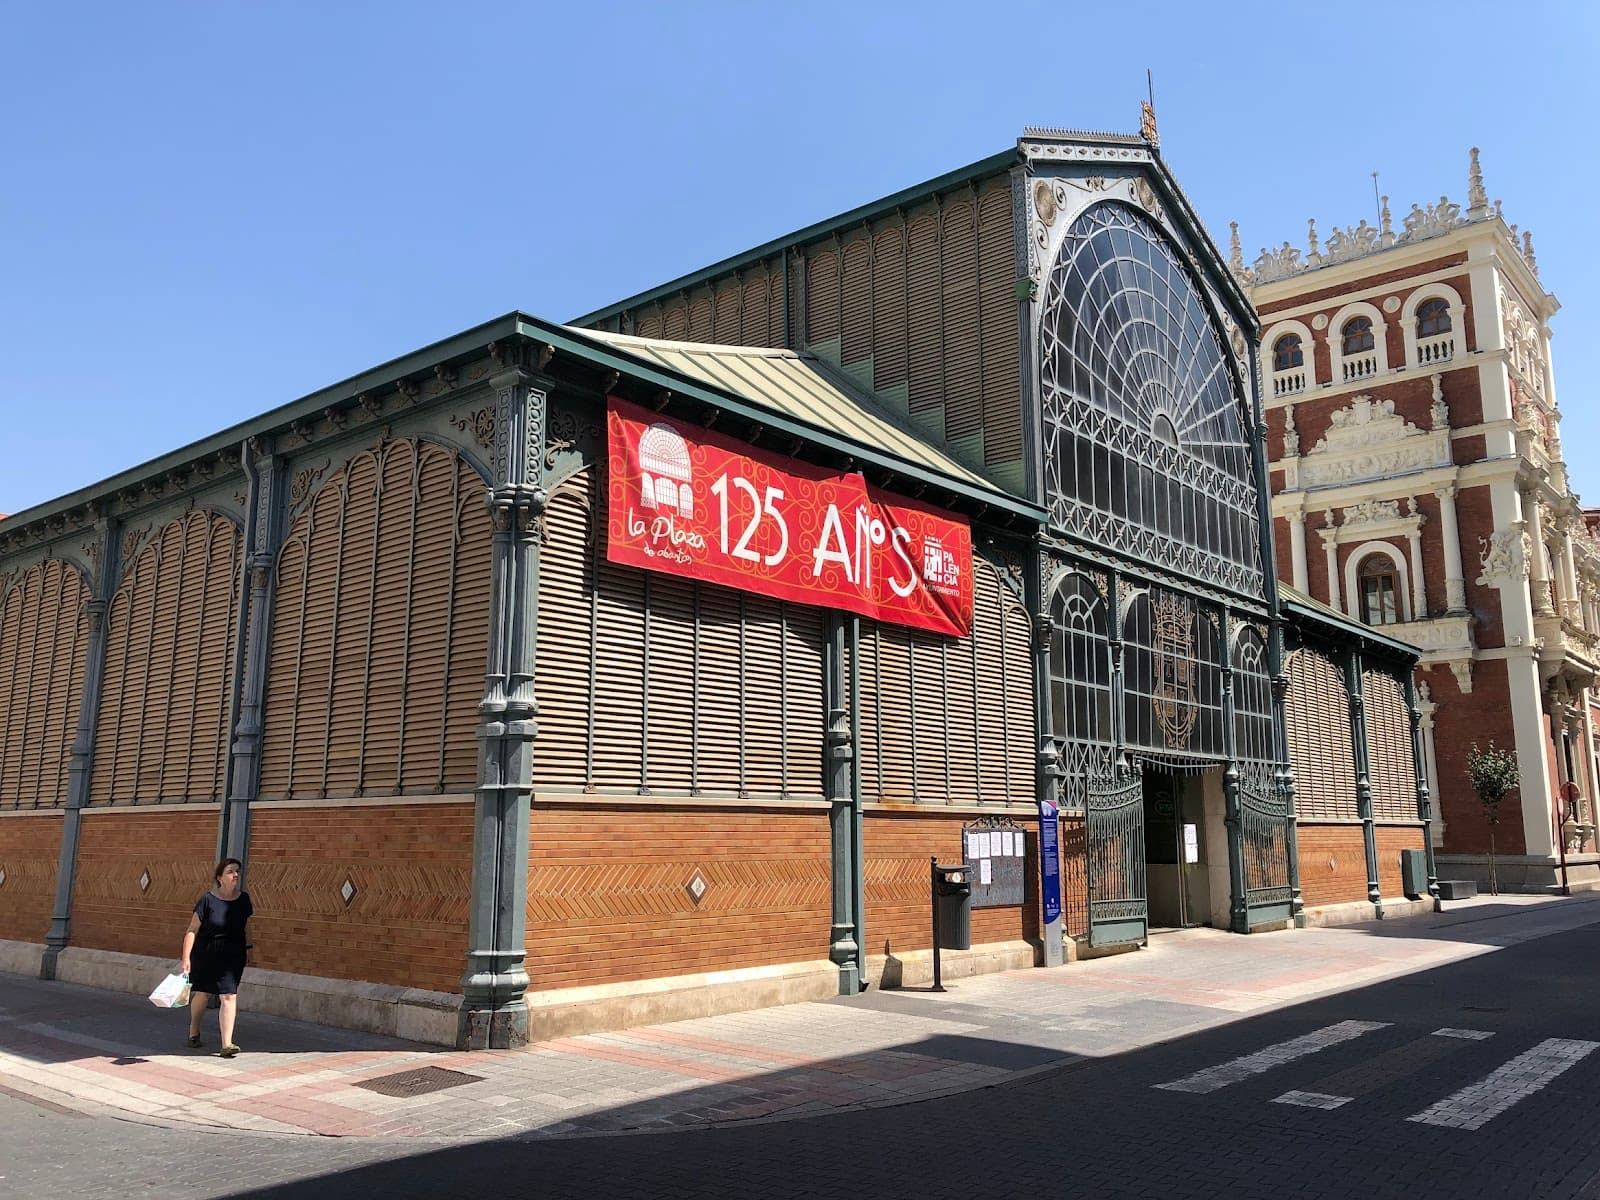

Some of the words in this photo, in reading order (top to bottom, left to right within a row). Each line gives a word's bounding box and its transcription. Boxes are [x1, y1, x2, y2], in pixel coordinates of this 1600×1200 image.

[651, 513, 706, 548] Plaza
[710, 472, 789, 567] 125
[813, 503, 919, 597] AÑOS
[643, 541, 655, 557] de
[657, 545, 692, 565] abastos
[943, 550, 954, 563] PA
[943, 562, 960, 576] LEN
[943, 573, 959, 586] CIA
